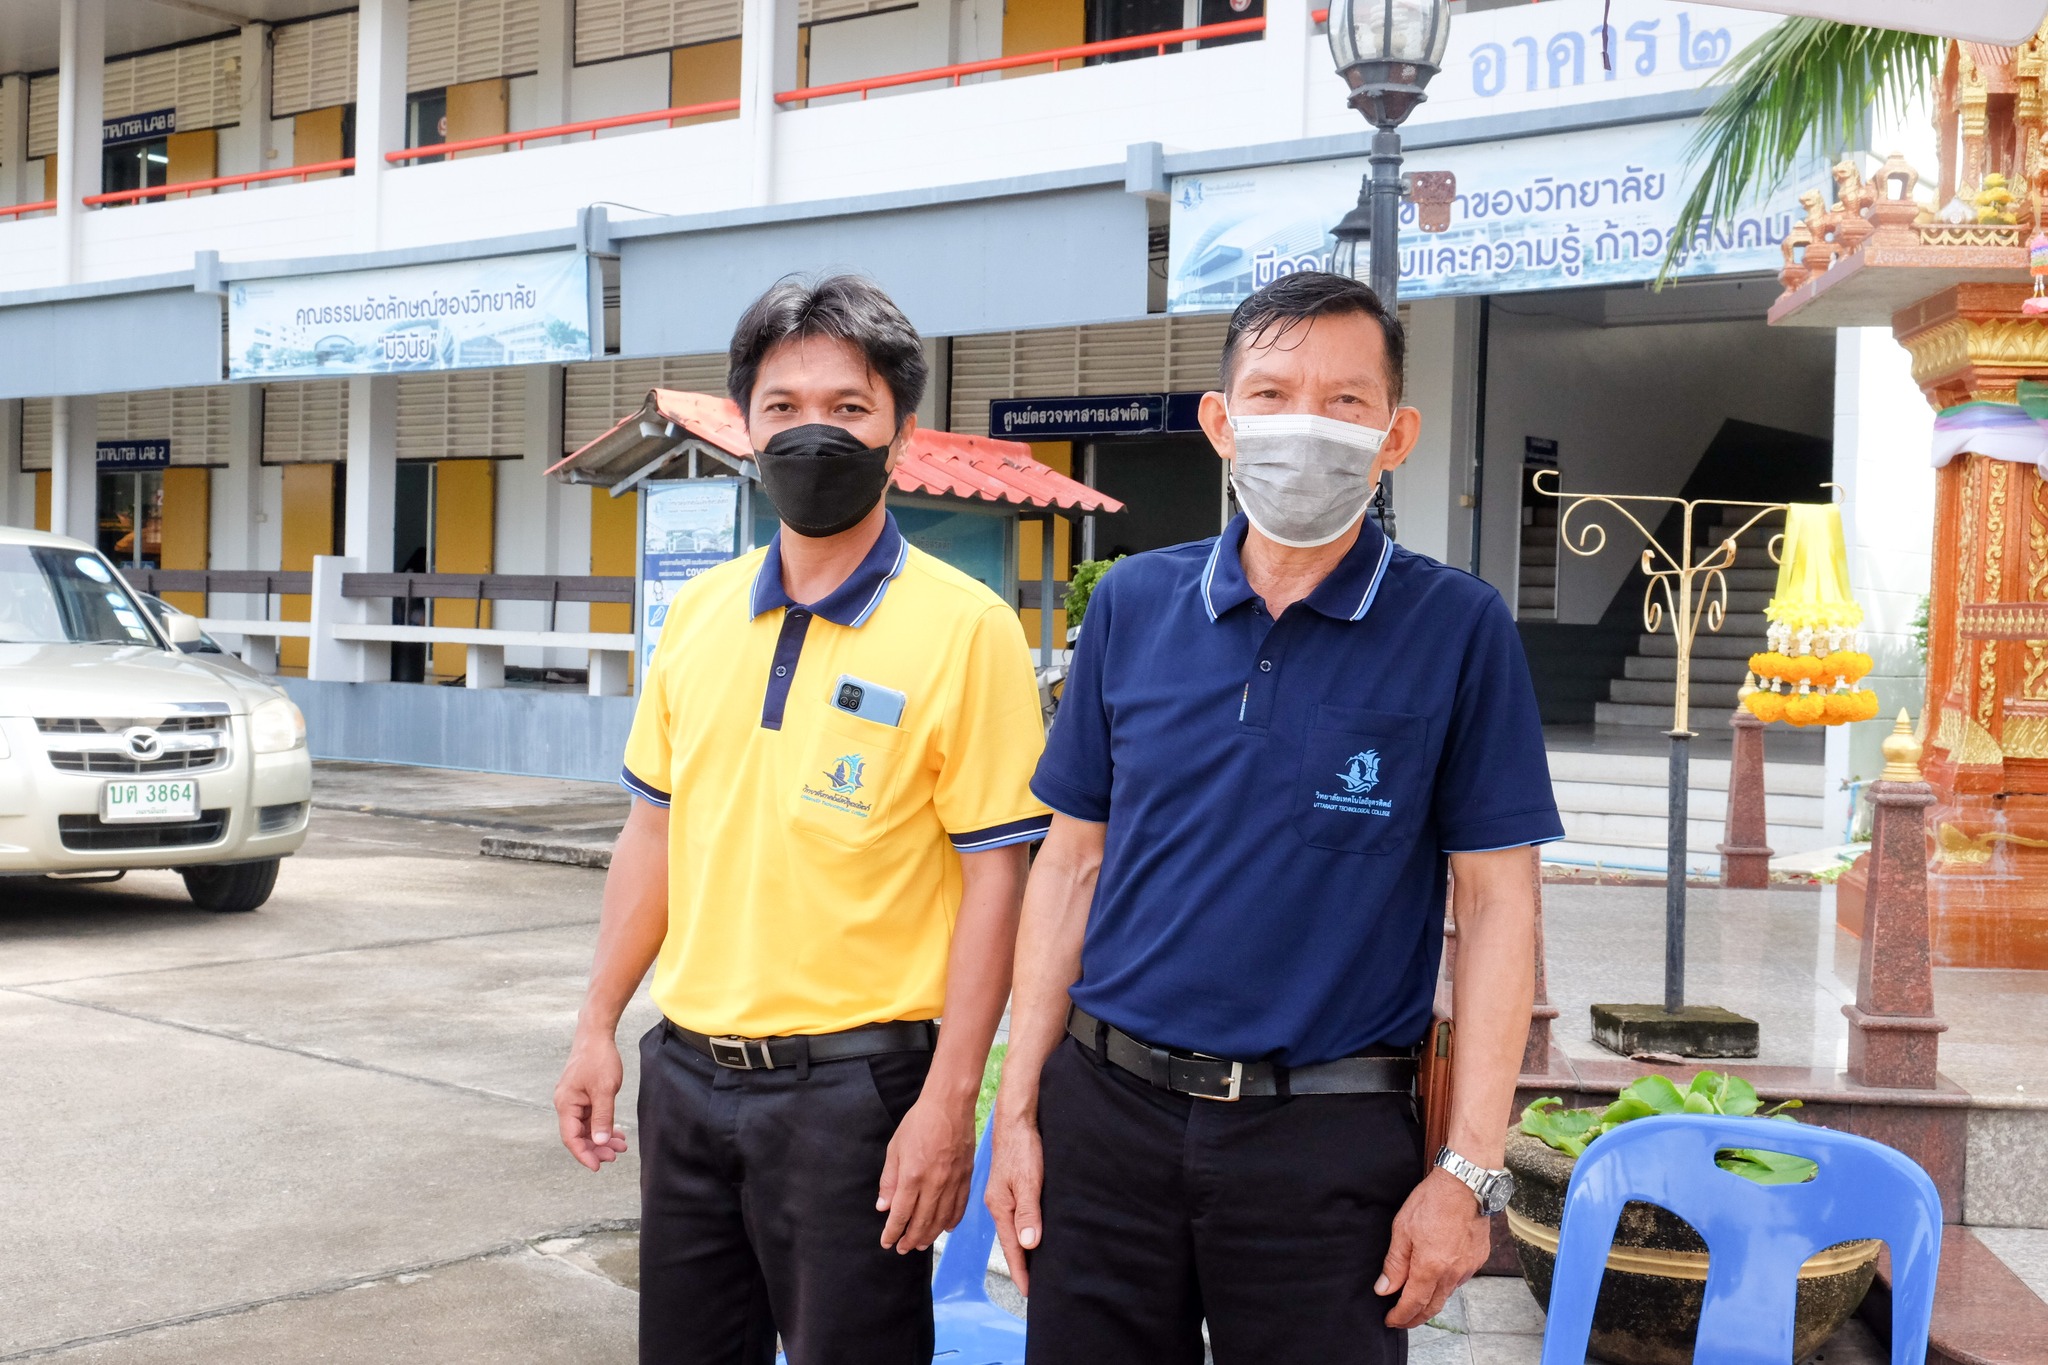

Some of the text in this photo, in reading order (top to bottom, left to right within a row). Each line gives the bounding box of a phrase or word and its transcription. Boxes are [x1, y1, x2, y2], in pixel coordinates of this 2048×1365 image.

[1469, 11, 1732, 97] อาคาร ๒
[103, 119, 142, 140] MPUTER
[144, 114, 166, 132] LAB
[296, 283, 536, 332] คุณธรรมอัตลักษณ์ของวิทยาลัย
[1003, 402, 1149, 432] ศูนย์ตรวจหาสารเสพติด
[96, 446, 165, 461] OMPUTER LAB 2
[146, 783, 192, 803] 3864
